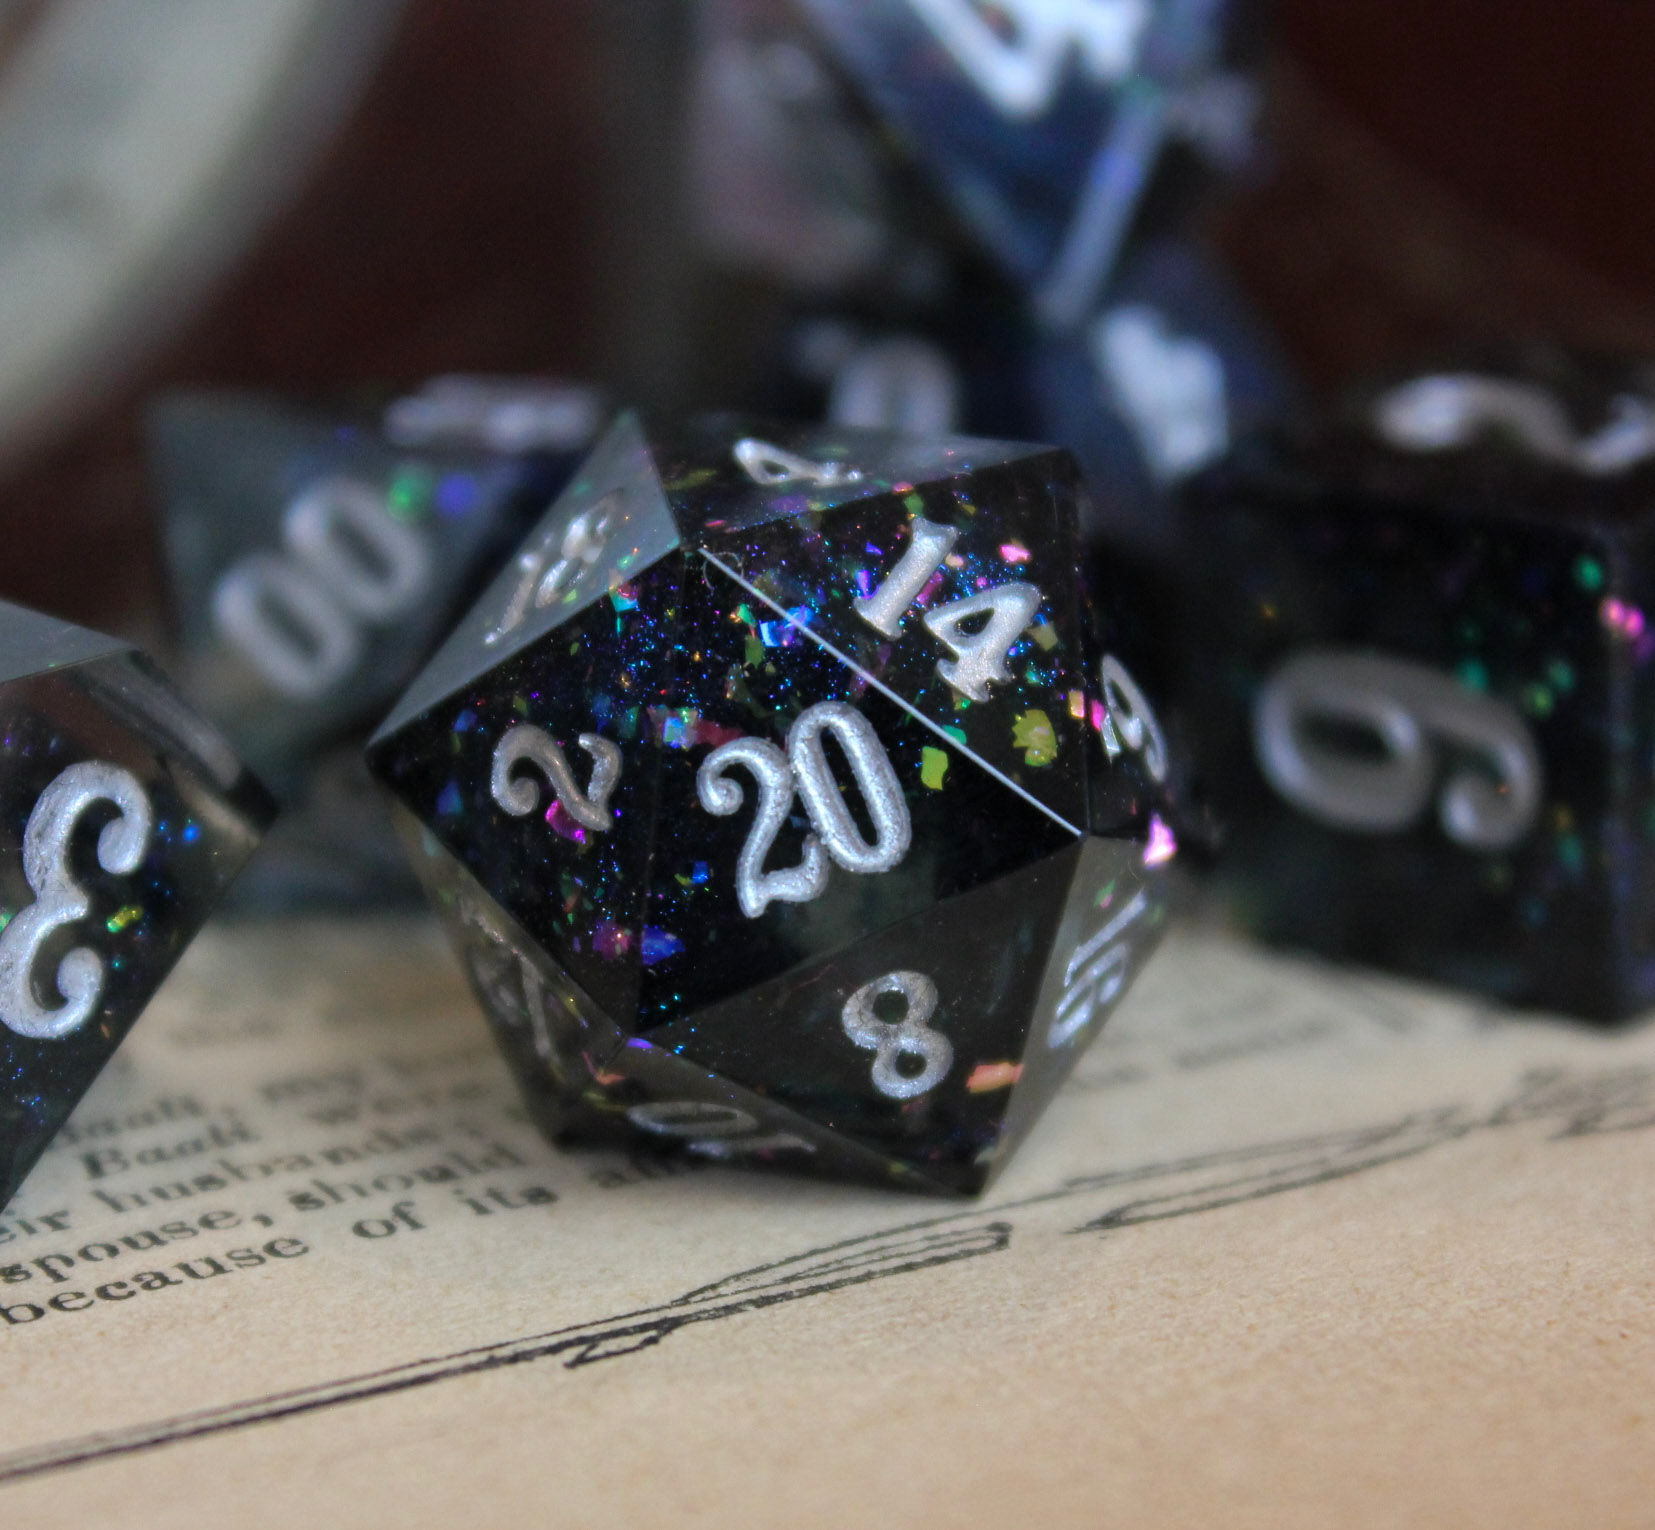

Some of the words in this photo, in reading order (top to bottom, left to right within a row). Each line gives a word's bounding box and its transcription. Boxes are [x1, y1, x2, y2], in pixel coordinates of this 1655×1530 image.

[853, 517, 1046, 704] 14
[490, 723, 624, 832] 2
[696, 700, 912, 919] 20
[841, 969, 955, 1101] 8
[0, 1207, 275, 1284] spouse,
[286, 1142, 524, 1214] should
[351, 1200, 426, 1240] of
[451, 1188, 560, 1217] its
